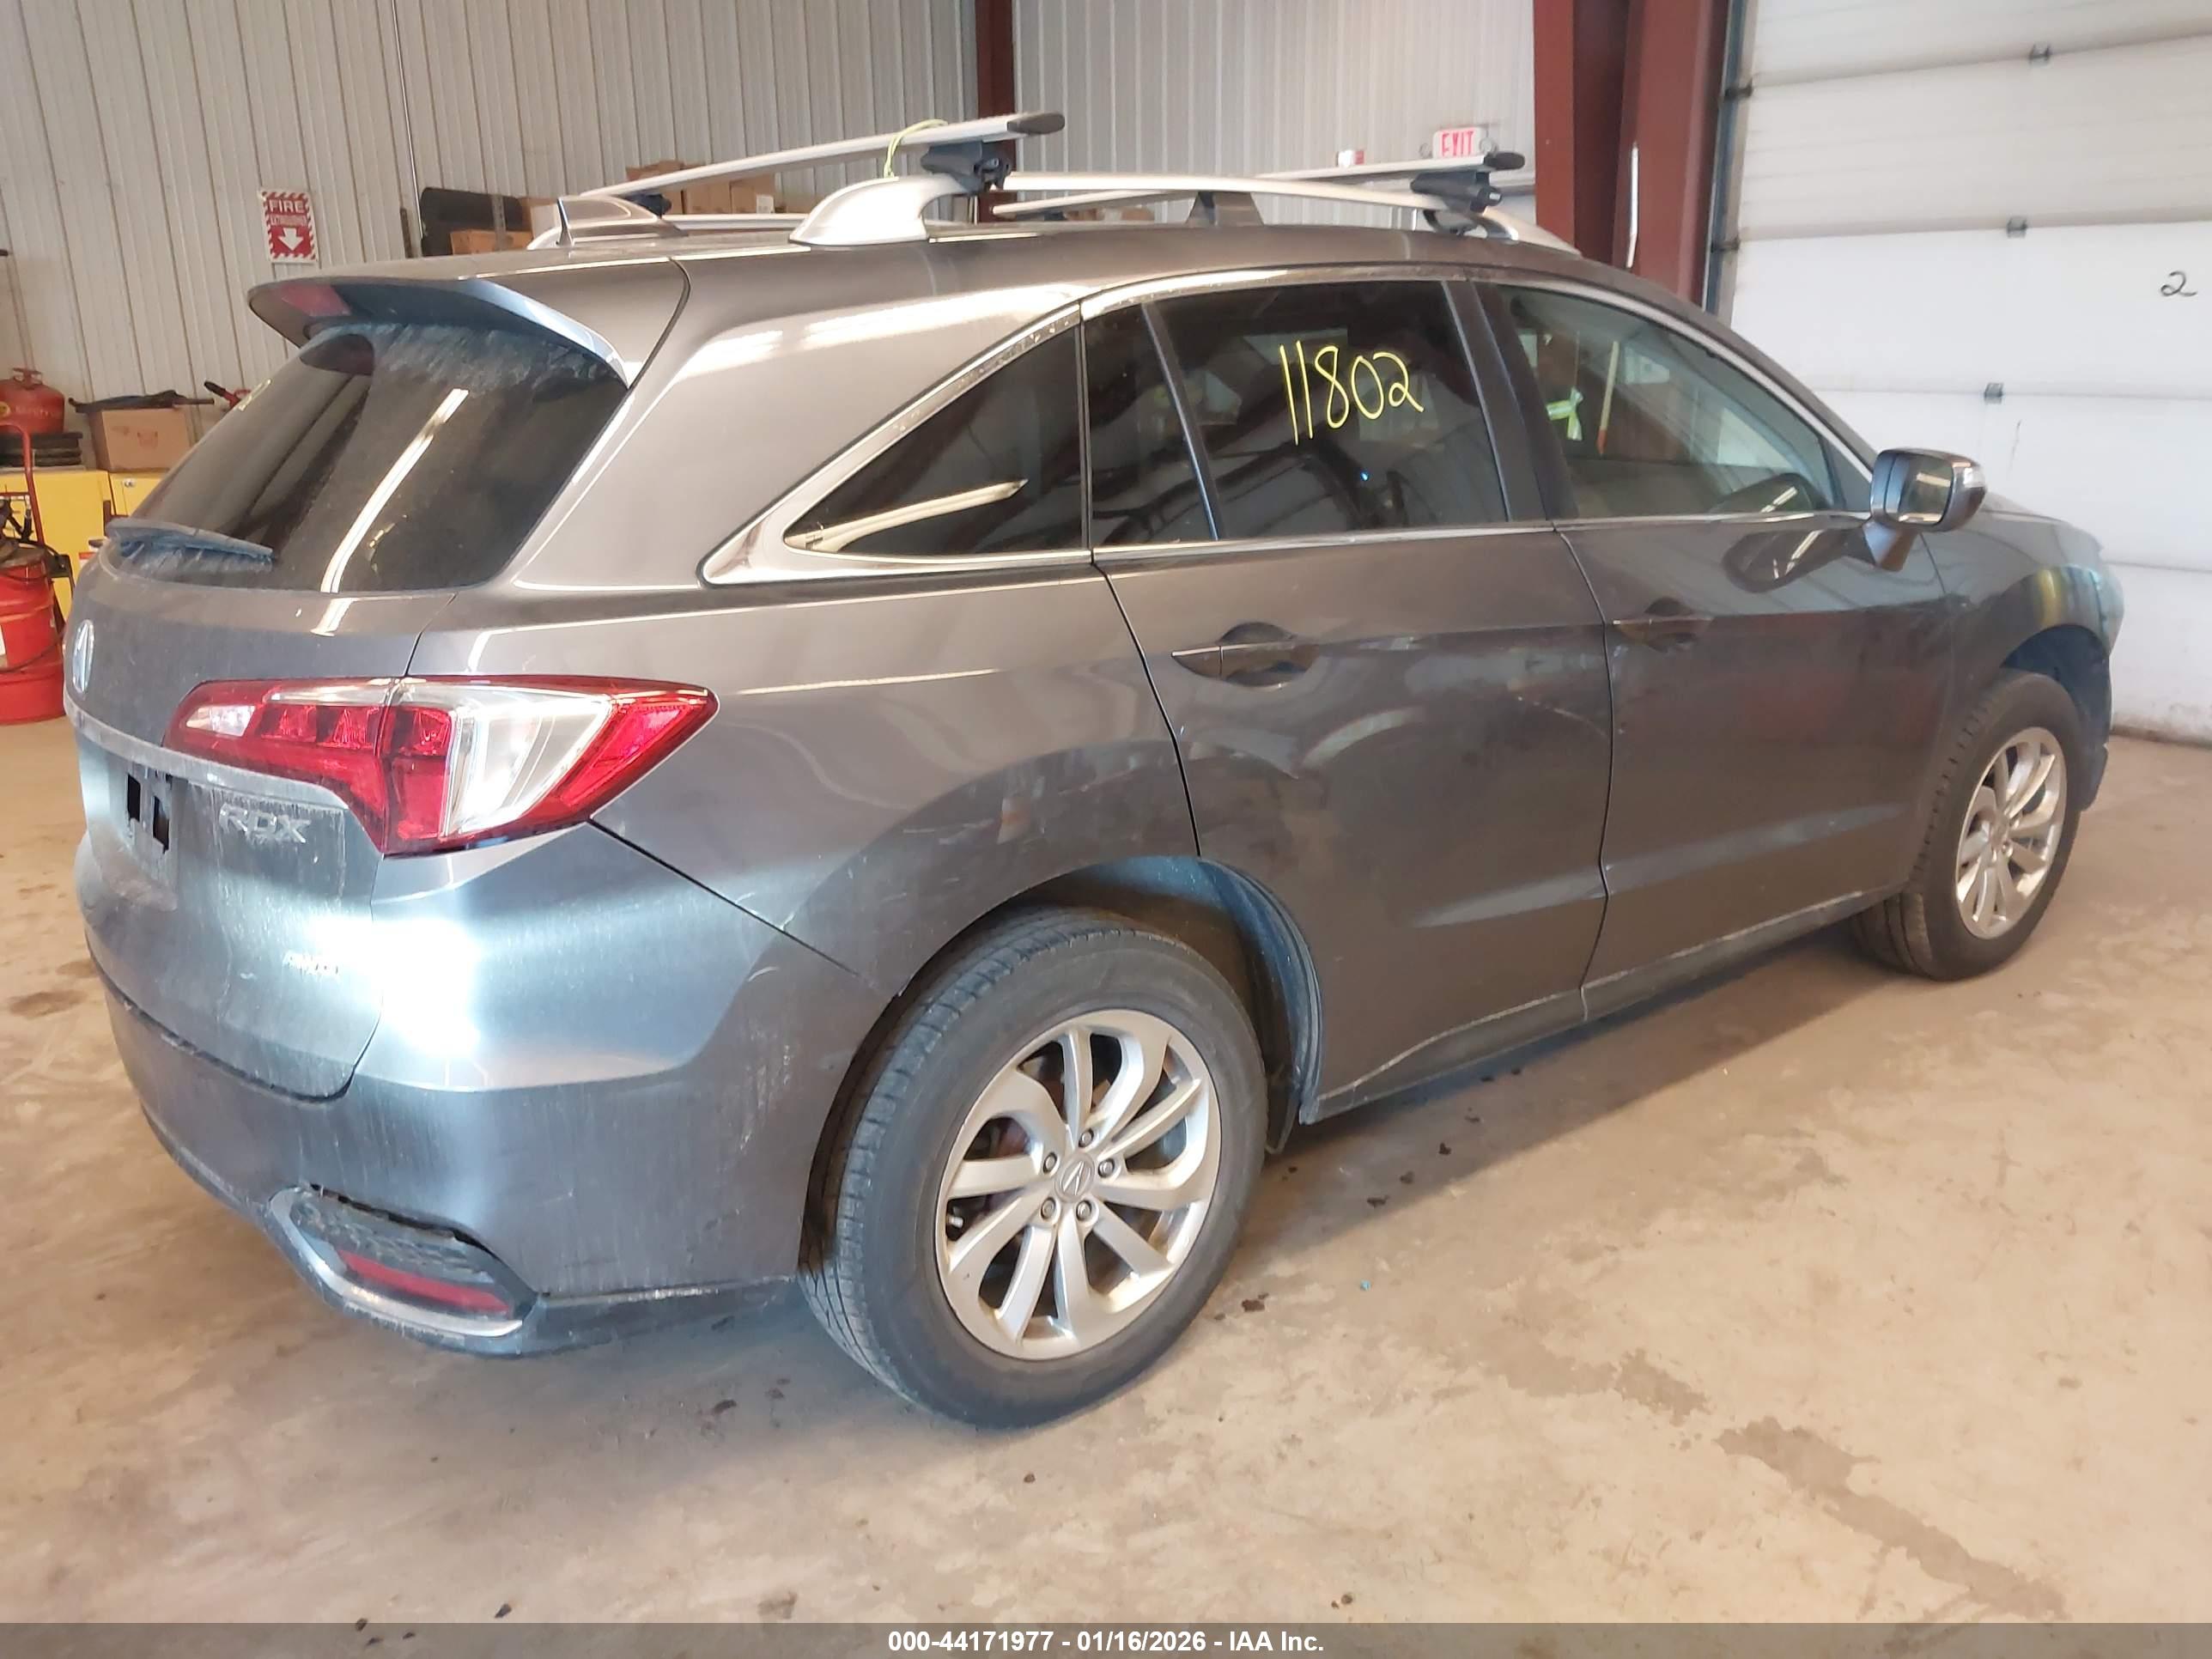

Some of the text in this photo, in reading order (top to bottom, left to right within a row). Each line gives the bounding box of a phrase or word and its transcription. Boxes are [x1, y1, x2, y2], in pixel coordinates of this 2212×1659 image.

[1442, 130, 1474, 157] EXIT
[269, 199, 305, 214] FIRE
[2160, 270, 2197, 297] 2
[1279, 340, 1425, 447] 11802
[219, 803, 313, 843] RDX
